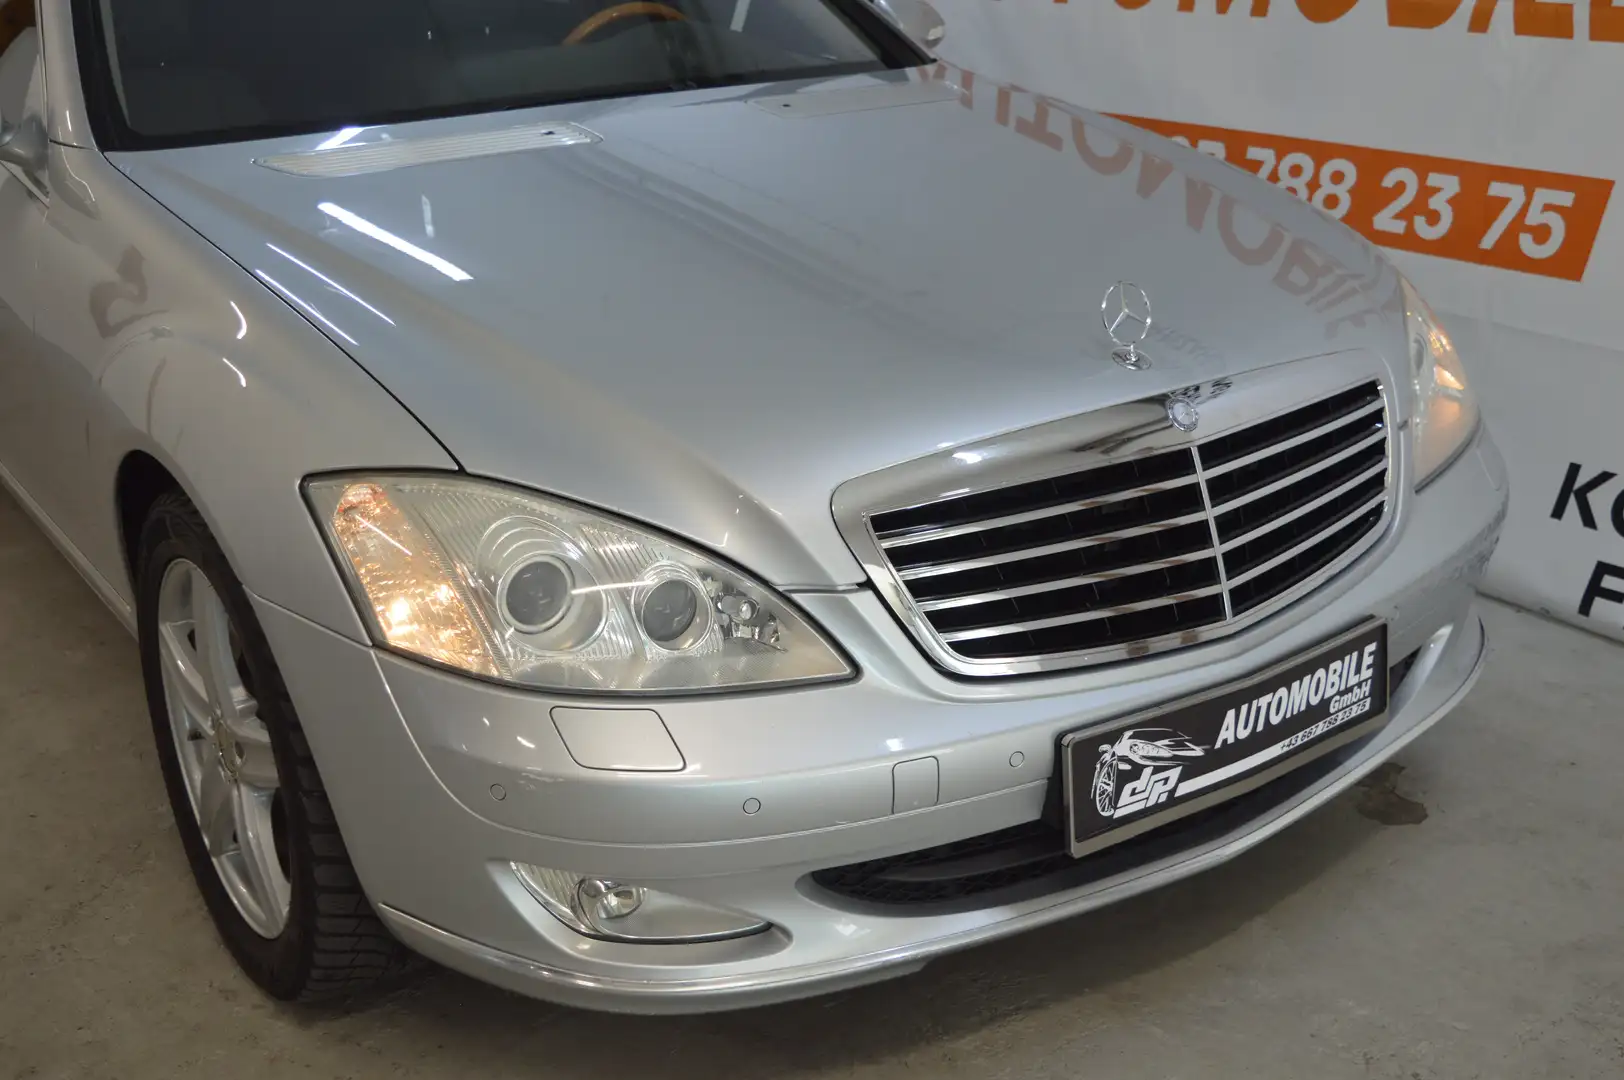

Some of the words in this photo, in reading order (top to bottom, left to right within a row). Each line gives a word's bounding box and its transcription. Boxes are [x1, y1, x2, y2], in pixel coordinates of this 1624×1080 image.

[1372, 167, 1460, 240] 23
[1478, 181, 1576, 260] 75
[1549, 461, 1624, 539] K
[1213, 641, 1378, 750] AUTOMOBILE
[1280, 735, 1299, 751] +43
[1301, 724, 1320, 742] 667
[1321, 716, 1338, 733] 788
[1340, 707, 1353, 721] 23
[1354, 700, 1367, 714] 75
[1328, 678, 1372, 714] GmbH
